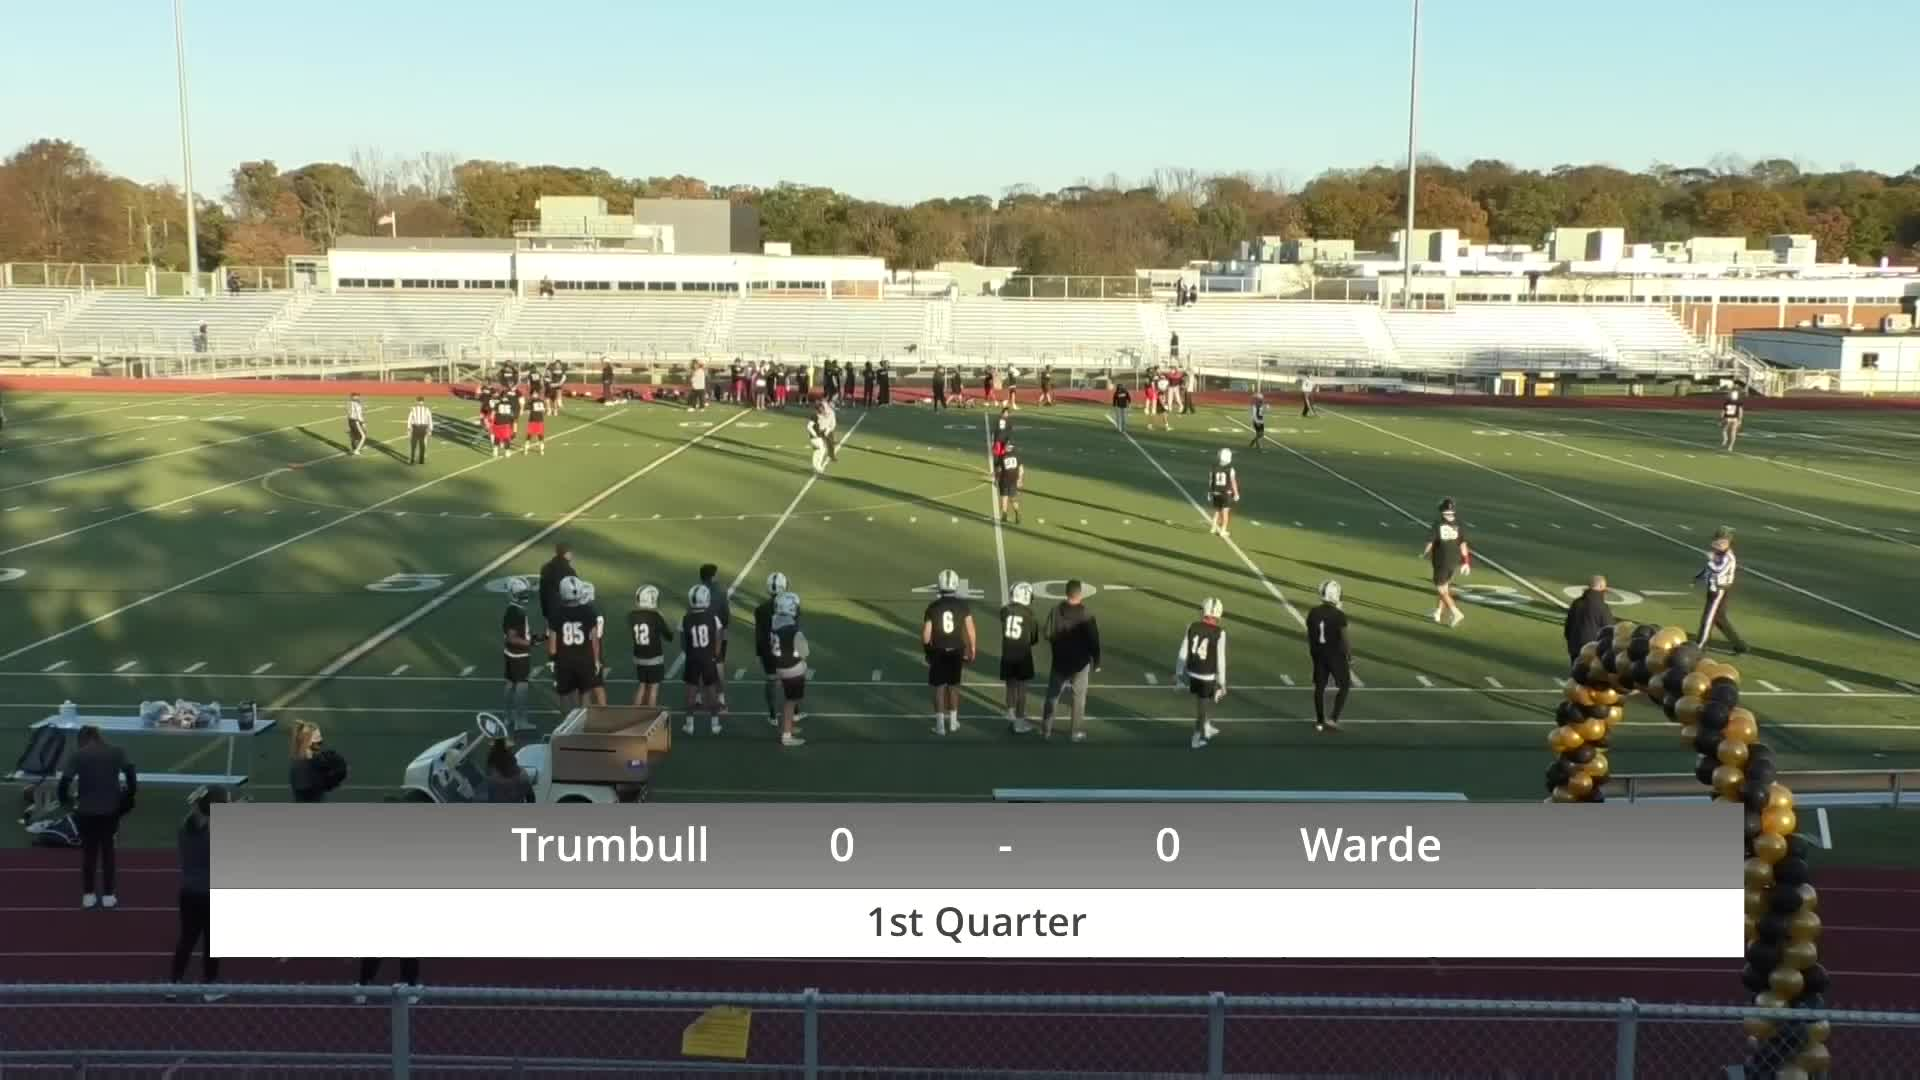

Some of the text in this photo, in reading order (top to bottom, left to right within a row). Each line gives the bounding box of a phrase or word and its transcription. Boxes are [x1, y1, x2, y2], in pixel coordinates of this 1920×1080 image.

[562, 621, 586, 646] 85
[632, 623, 651, 645] 12
[942, 610, 955, 634] 6
[1004, 614, 1025, 640] 15
[1318, 620, 1328, 644] 1
[1190, 633, 1210, 661] 14
